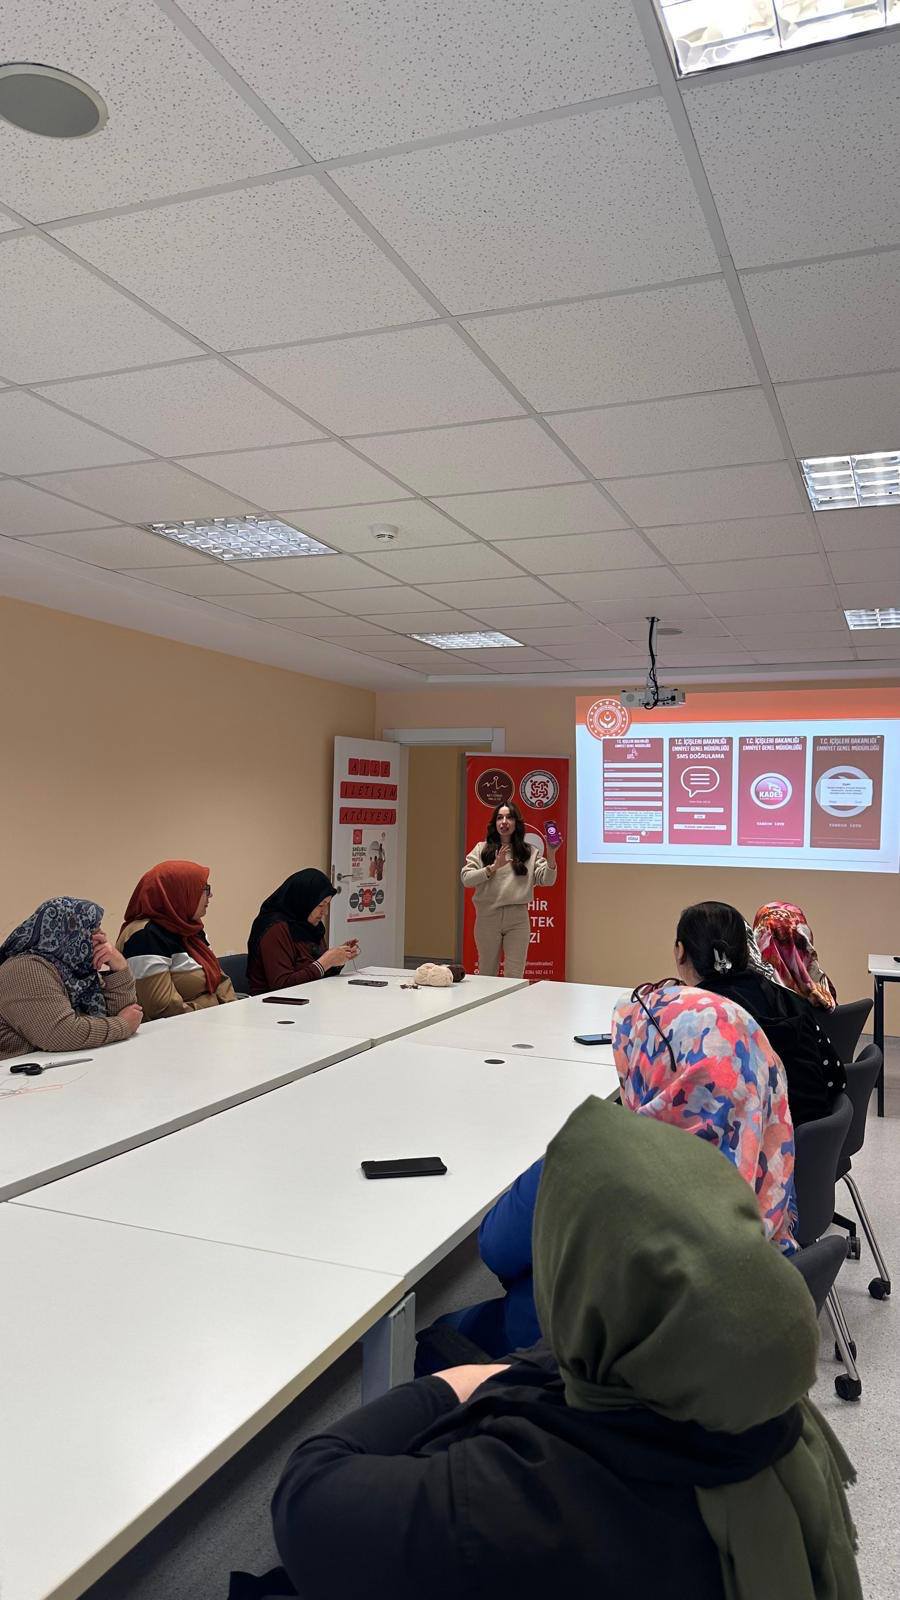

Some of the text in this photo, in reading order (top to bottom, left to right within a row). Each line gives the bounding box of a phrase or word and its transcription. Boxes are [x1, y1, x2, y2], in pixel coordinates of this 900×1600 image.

[527, 898, 548, 911] HİR
[530, 916, 554, 928] TEK
[529, 930, 540, 944] Zİ
